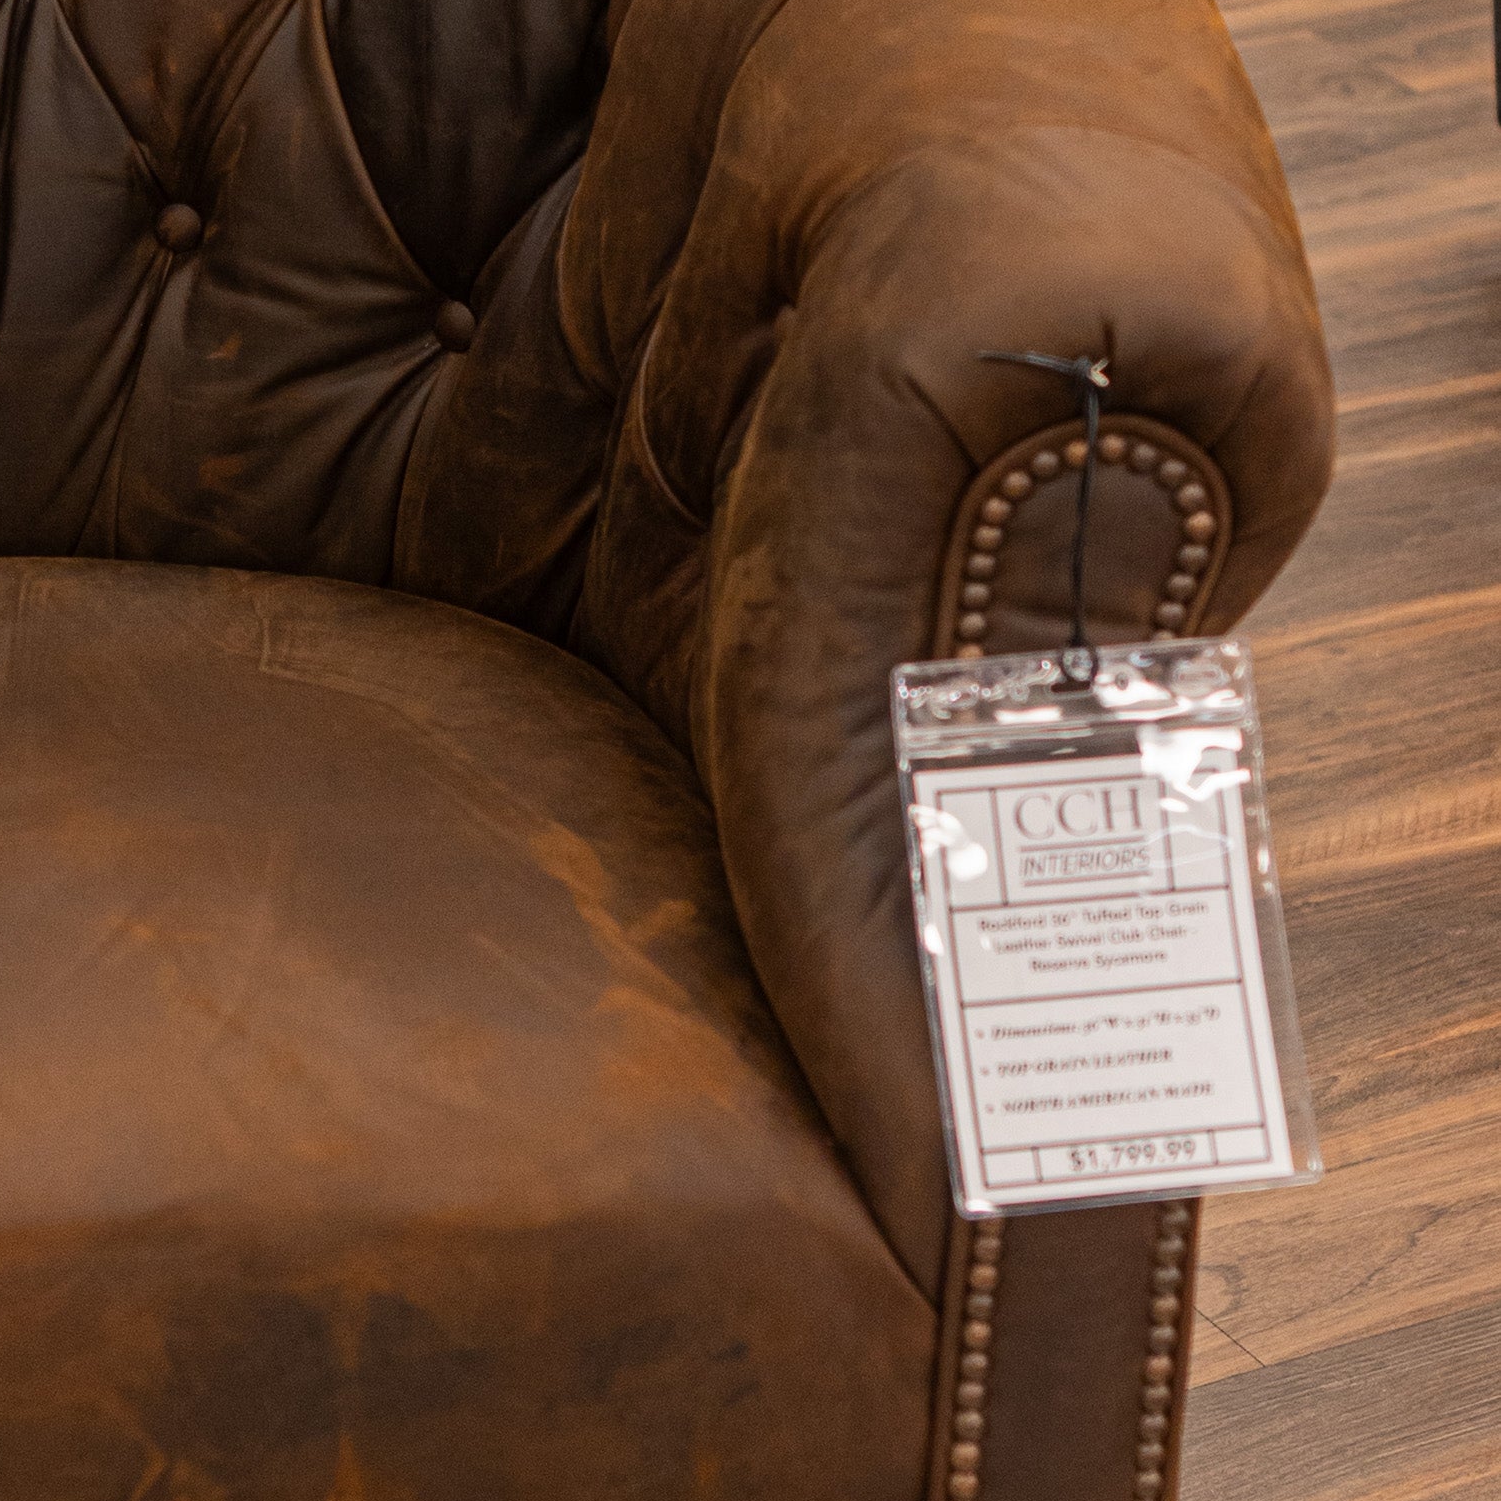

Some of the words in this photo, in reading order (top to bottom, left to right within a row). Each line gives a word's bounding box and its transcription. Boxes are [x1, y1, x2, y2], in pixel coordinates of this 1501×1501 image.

[1013, 785, 1143, 841] CCH
[1021, 846, 1150, 878] INTERIORS
[1083, 906, 1131, 923] Tufted
[1135, 903, 1162, 919] Top
[1167, 899, 1207, 916] Grain
[1109, 926, 1142, 944] Club
[998, 1061, 1030, 1078] TOP
[1092, 1048, 1171, 1069] LEATHER
[1069, 1139, 1196, 1173] $1,799.99
